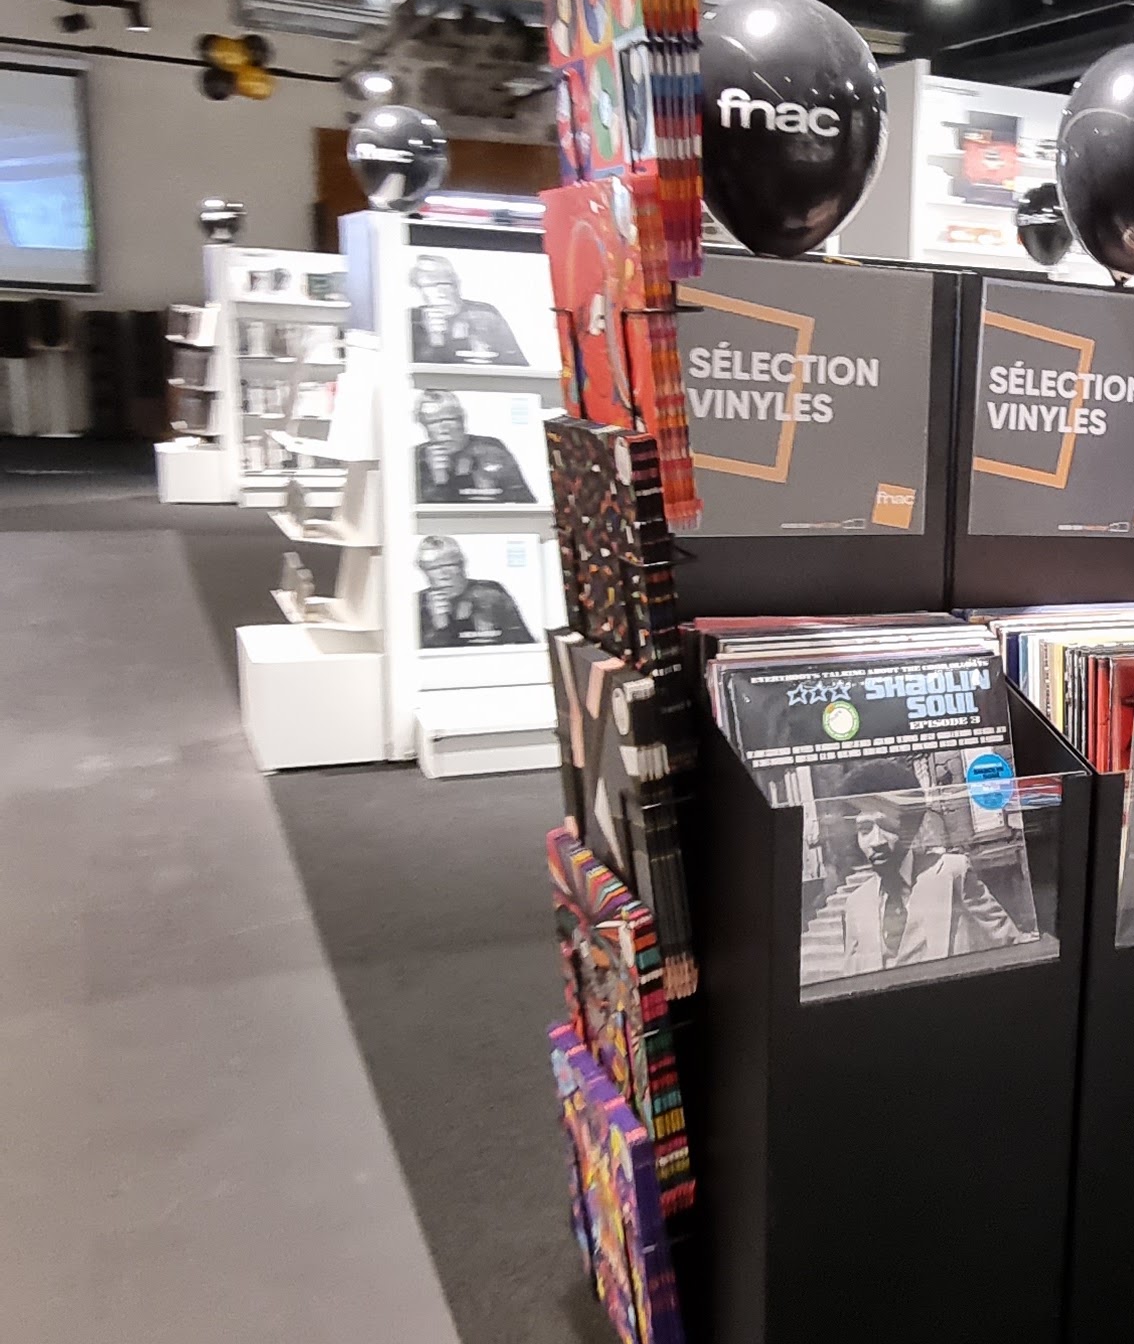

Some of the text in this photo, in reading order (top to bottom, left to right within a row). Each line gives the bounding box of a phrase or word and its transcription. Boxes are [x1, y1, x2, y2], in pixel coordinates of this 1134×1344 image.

[717, 87, 840, 137] fnac
[688, 341, 880, 387] SÉLECTION
[686, 388, 834, 423] VINYLES
[986, 401, 1108, 435] VINYLES
[876, 491, 916, 506] fnac
[906, 691, 979, 719] SOUL
[909, 716, 969, 730] EPISODE
